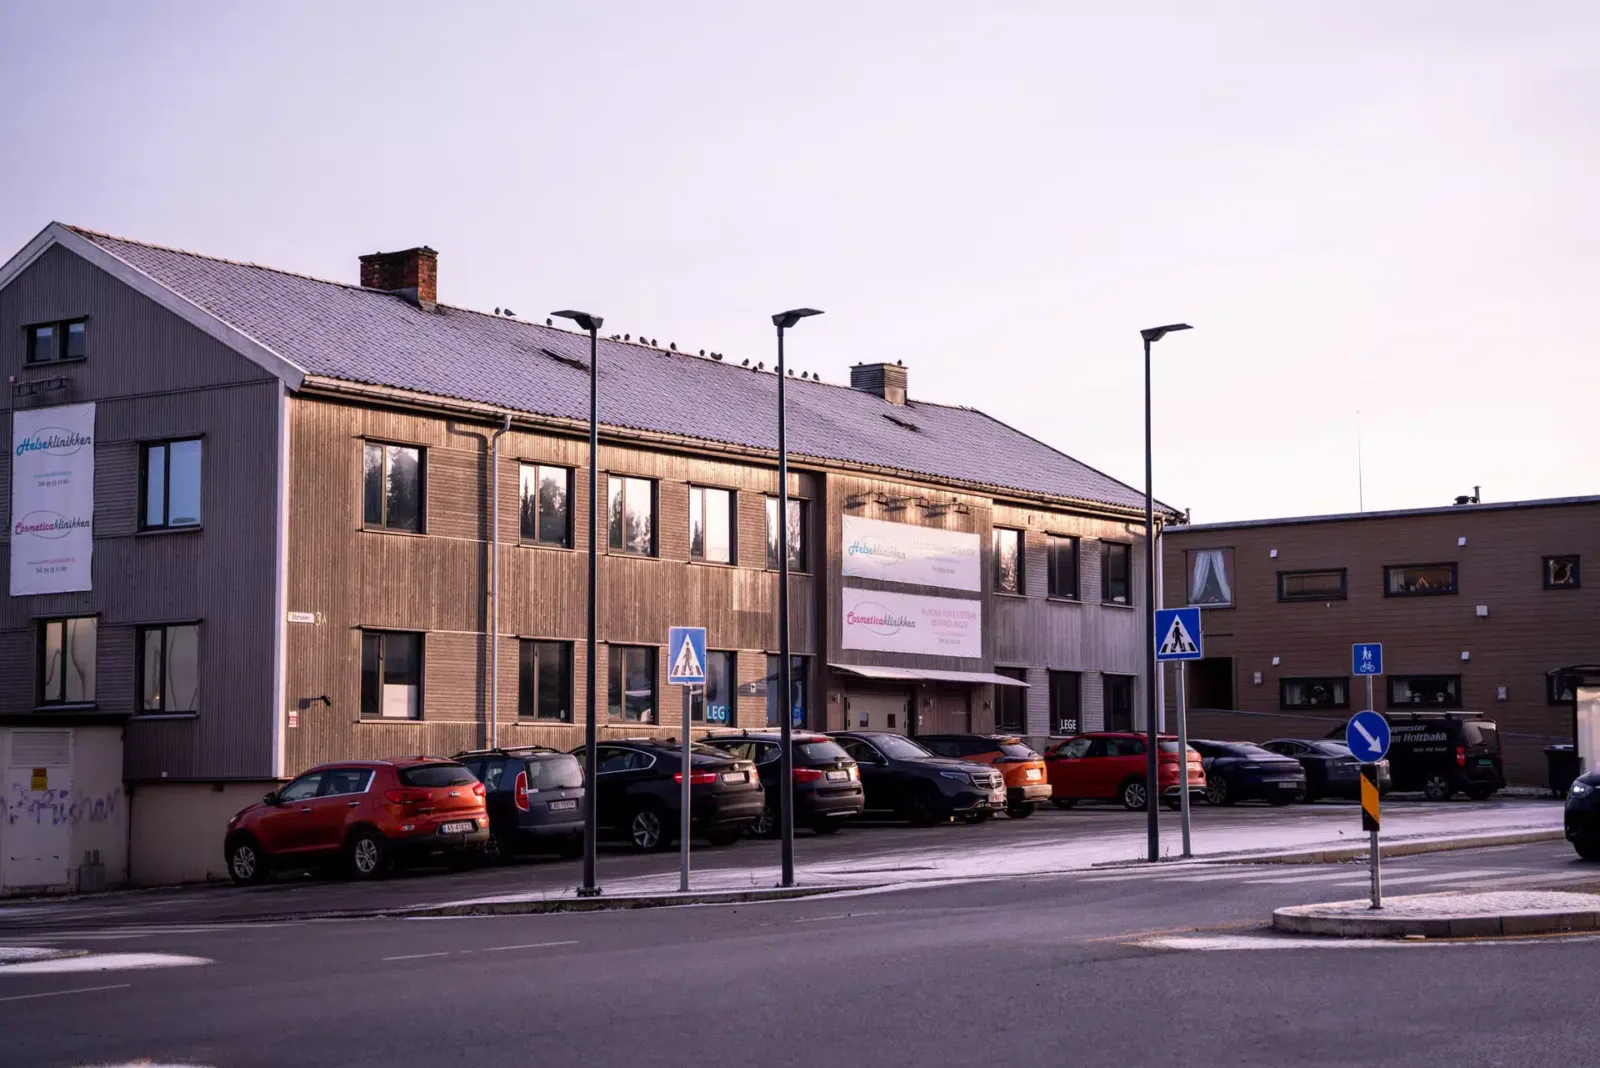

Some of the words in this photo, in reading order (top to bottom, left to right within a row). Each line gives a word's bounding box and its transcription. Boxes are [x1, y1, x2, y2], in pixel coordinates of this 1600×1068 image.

[16, 433, 91, 456] Helseklinikken
[15, 517, 90, 535] Cosmeticaklinikken
[846, 611, 916, 628] Cosmeticaklinikken
[1060, 718, 1076, 730] LEGE
[1390, 725, 1427, 734] ggmester
